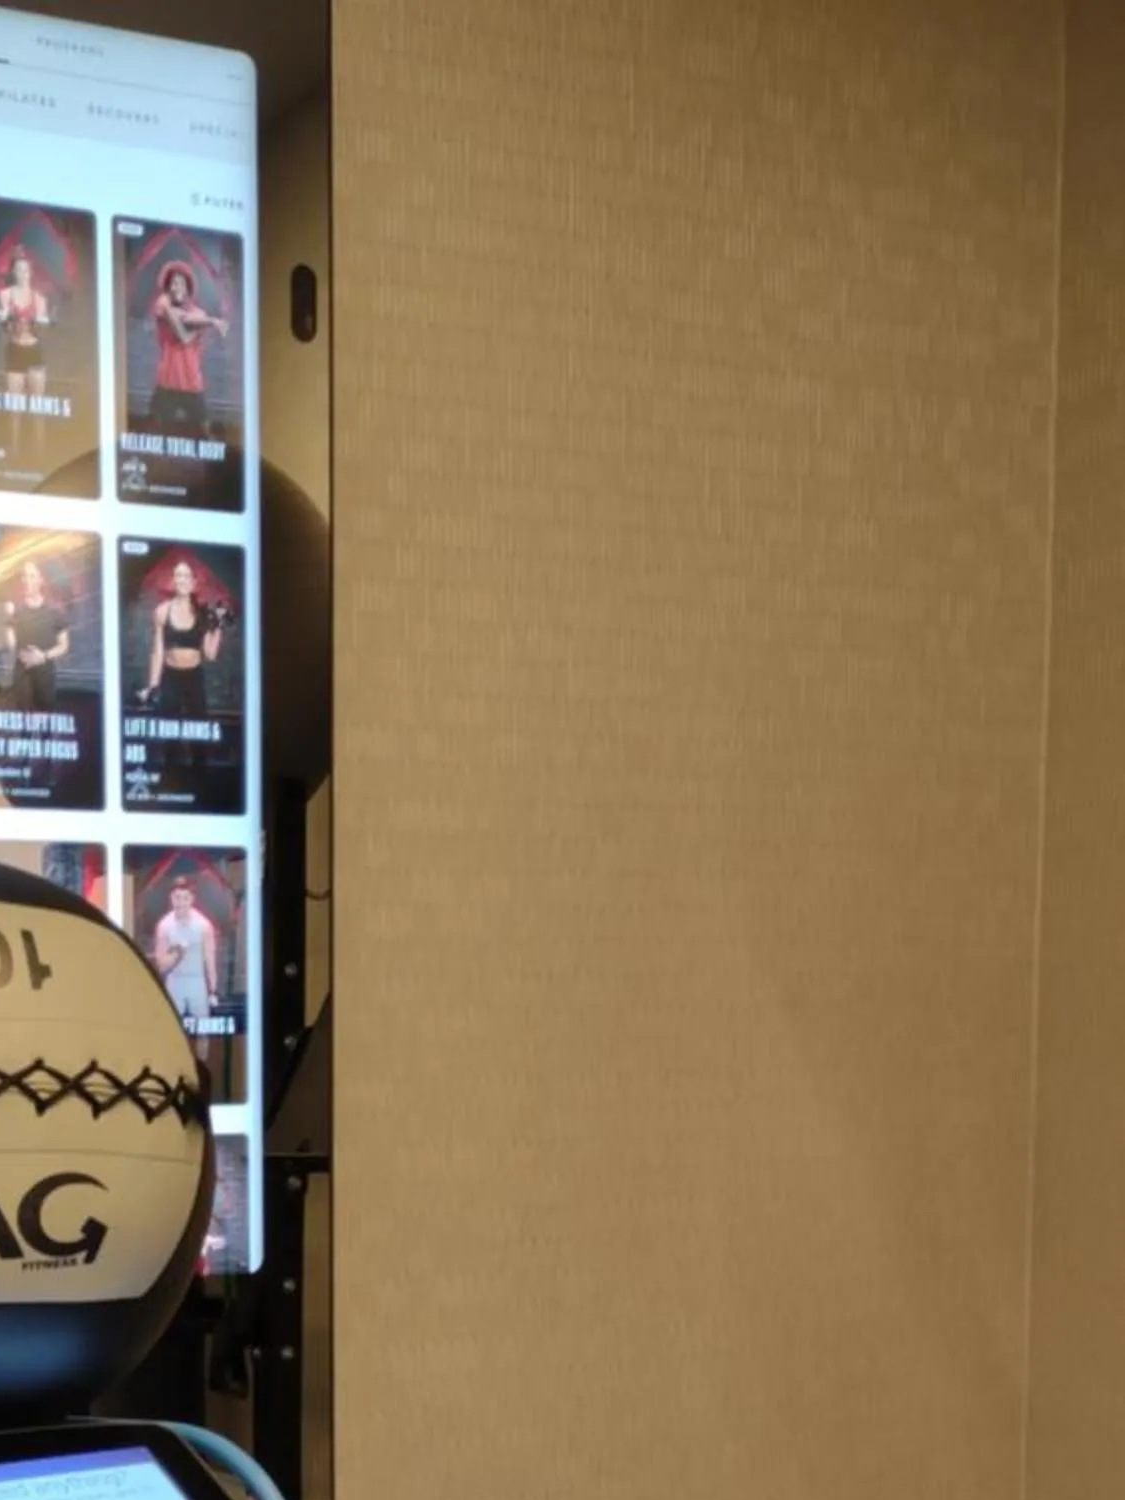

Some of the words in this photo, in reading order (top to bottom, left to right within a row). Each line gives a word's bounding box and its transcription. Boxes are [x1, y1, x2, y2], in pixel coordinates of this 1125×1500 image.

[86, 101, 161, 125] RECOVERY
[4, 393, 27, 413] RUN
[29, 396, 60, 416] ARMS
[120, 432, 164, 455] RELEASE
[166, 437, 197, 458] TOTAL
[199, 441, 225, 461] BODY
[25, 712, 49, 733] LIFT
[50, 714, 75, 734] FULL
[125, 718, 148, 737] LIFT
[181, 720, 209, 740] ARMS
[8, 739, 42, 759] UPPER
[44, 741, 79, 760] FOCUS
